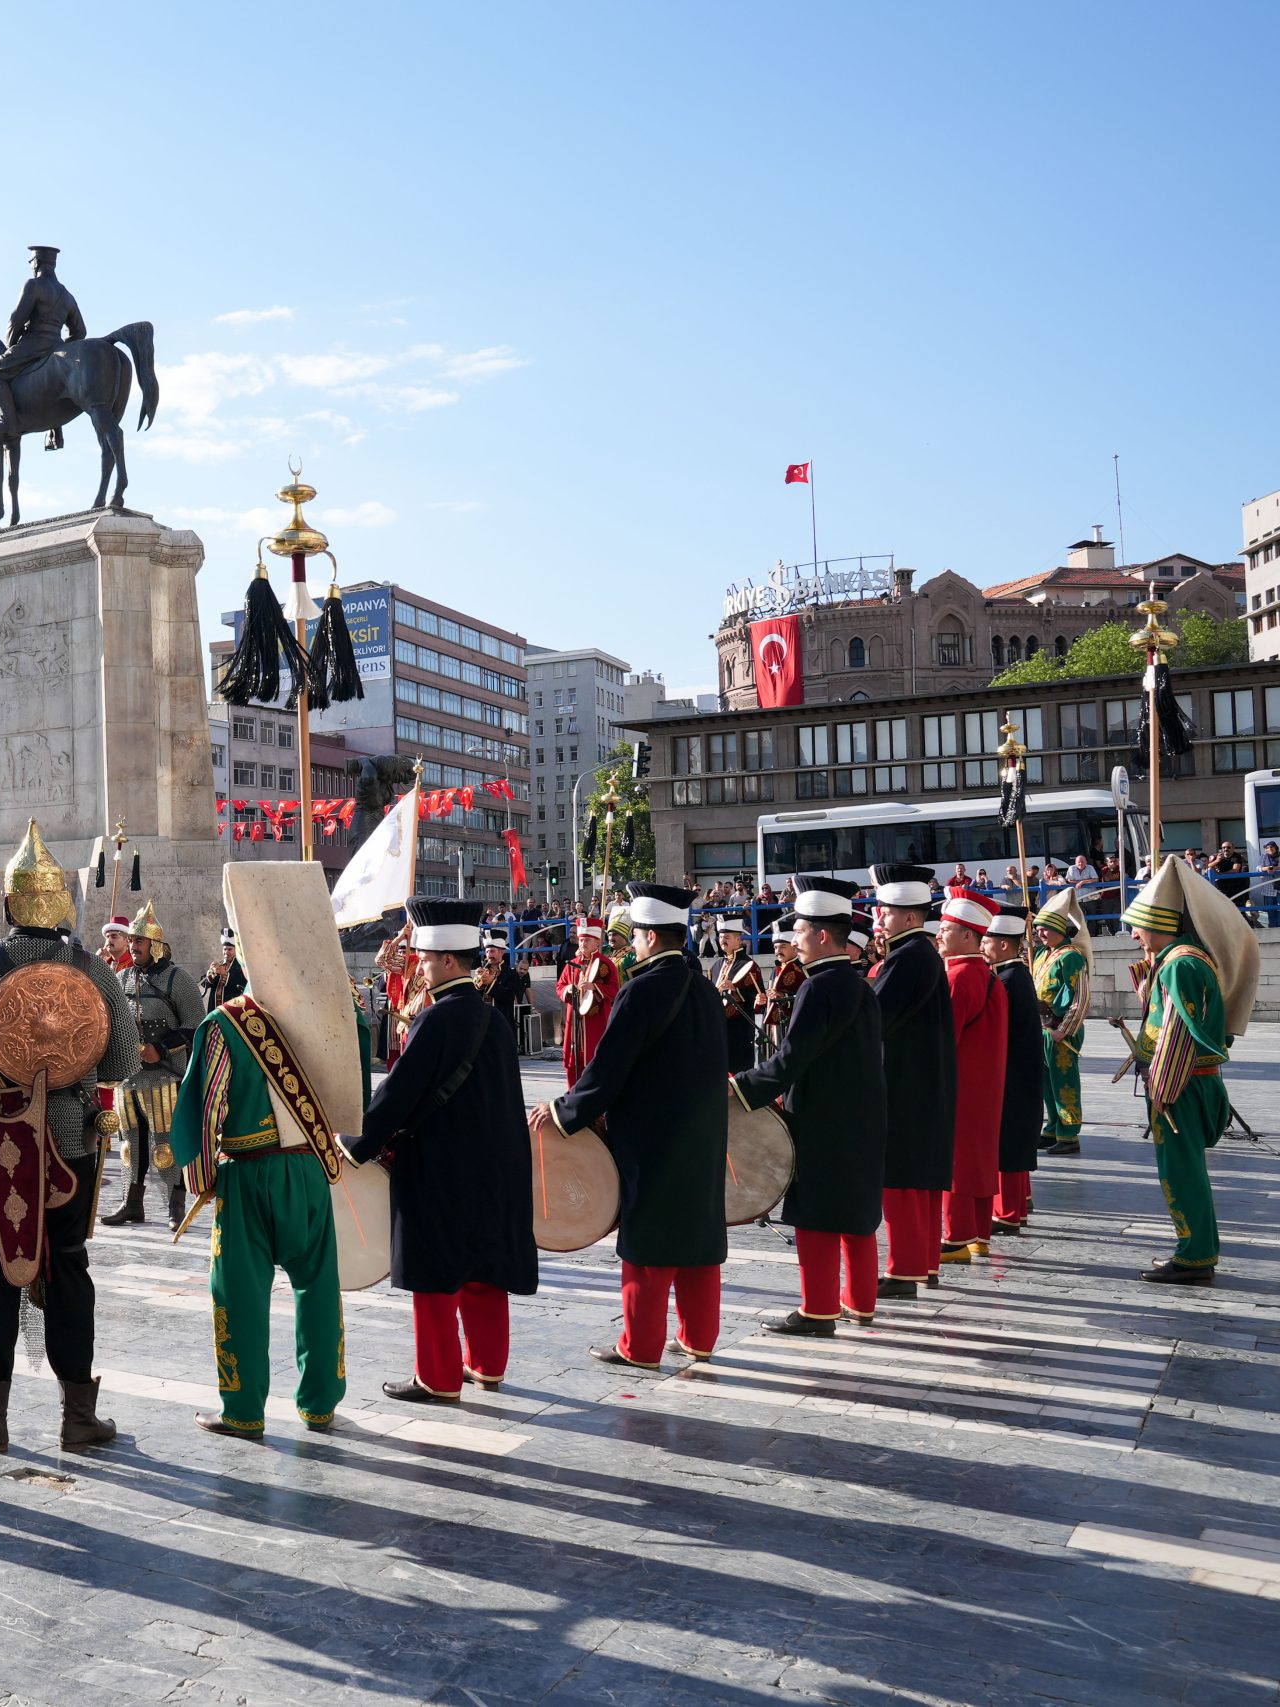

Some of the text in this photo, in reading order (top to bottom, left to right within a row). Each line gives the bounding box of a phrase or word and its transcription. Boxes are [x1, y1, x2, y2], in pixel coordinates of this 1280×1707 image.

[724, 585, 764, 617] RKİYE
[795, 566, 894, 599] BANKASI
[342, 598, 387, 613] MPANYA
[349, 624, 380, 643] KSİT
[354, 645, 386, 655] EKLİYOR!
